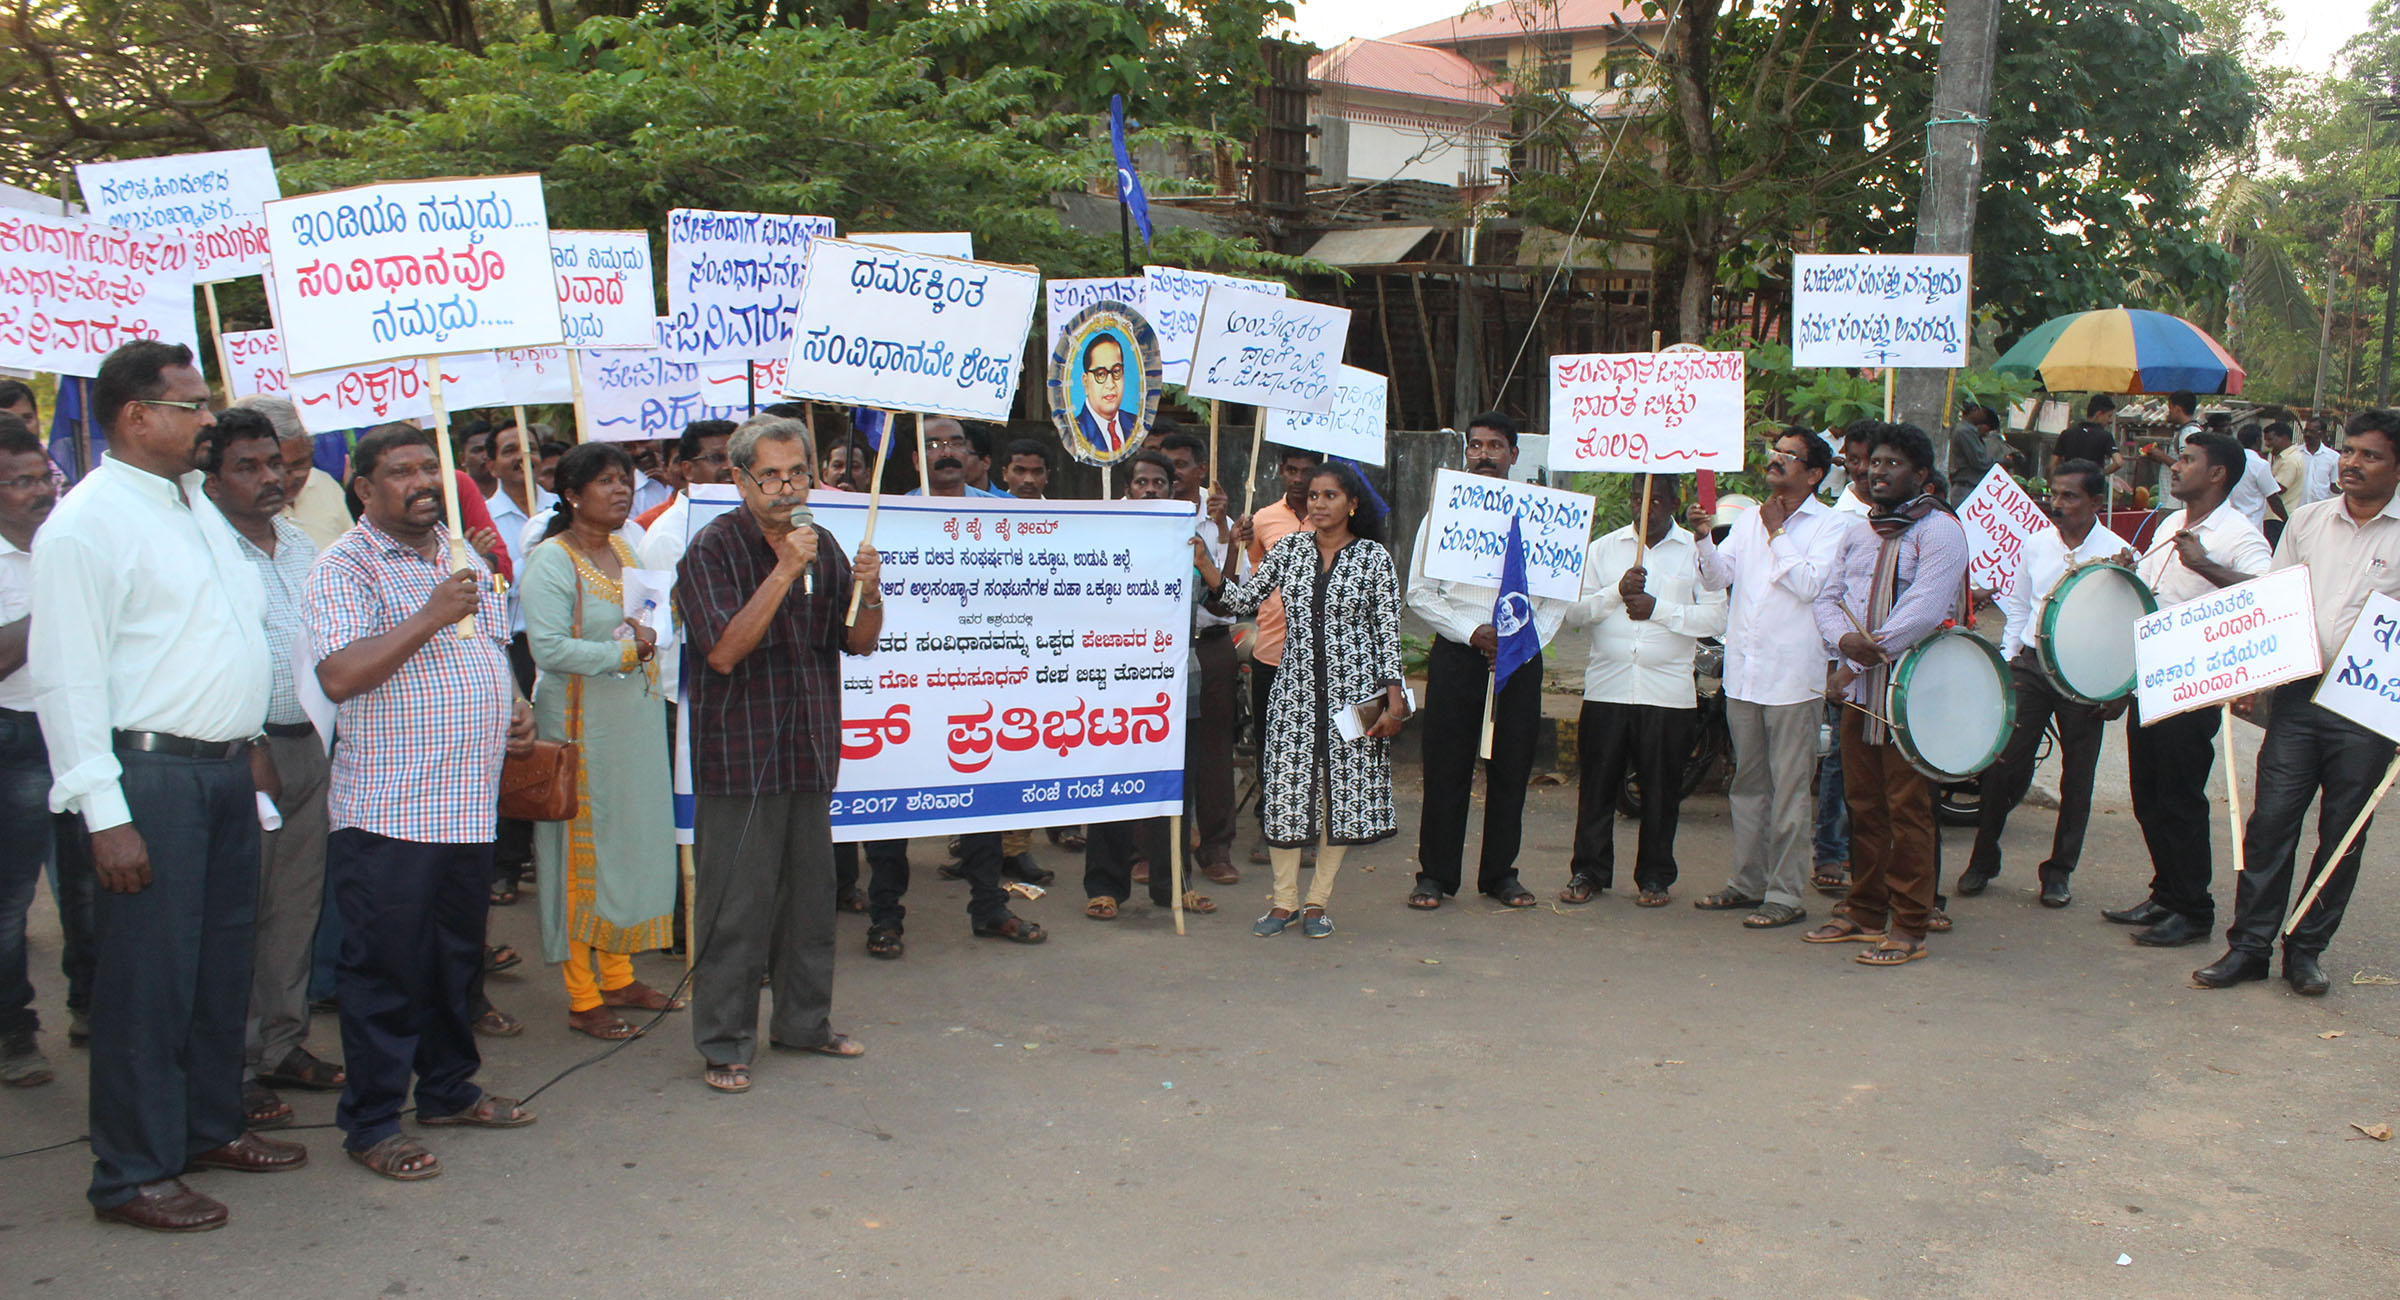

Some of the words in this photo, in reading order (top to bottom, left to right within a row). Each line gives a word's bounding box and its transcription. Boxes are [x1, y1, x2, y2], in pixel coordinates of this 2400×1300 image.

[296, 243, 506, 298] ಸಂವಿಧಾನವೂ
[689, 252, 806, 293] ಸಂವಿಧಾನವೇ
[851, 256, 988, 314] ಧರ್ಮಕ್ಕಿಂತ
[803, 325, 953, 377] ಸಂವಿಧಾನವೇ
[1572, 385, 1638, 424] ಭಾರತ
[1017, 520, 1059, 535] ಭೀಮ್
[925, 547, 955, 566] ದಲಿತ
[1074, 549, 1108, 567] ಉಡುಪಿ
[910, 577, 980, 607] ಅಲ್ಪಸಂಖ್ಯಾತ
[984, 577, 1049, 599] ಸಂಘಟನೆಗಳ
[1054, 579, 1081, 597] ಮಹಾ
[1086, 579, 1122, 605] ಒಕ್ಕೂಟ
[1127, 578, 1160, 597] ಉಡುಪಿ
[958, 613, 982, 625] ಇವರ
[2139, 612, 2173, 641] ದಲಿತ
[916, 630, 1030, 658] ಸಂವಿಧಾನವನ್ನು
[1036, 629, 1074, 656] ಒಪ್ಪದ
[1082, 628, 1147, 648] ಪೇಜಾವರ
[1153, 629, 1173, 653] ಶ್ರೀ
[844, 676, 873, 694] ಮತ್ತು
[1036, 664, 1069, 684] ದೇಶ
[1076, 666, 1107, 690] ಬಿಟ್ಟು
[1114, 661, 1175, 682] ತೊಲಗಲಿ
[947, 691, 1171, 774] ಪ್ರತಿಭಟನೆ
[906, 788, 974, 811] ಶನಿವಾರ
[1022, 782, 1060, 804] ಸಂಜೆ
[1067, 778, 1105, 800] ಗಂಟೆ
[1110, 778, 1146, 796] 4:00
